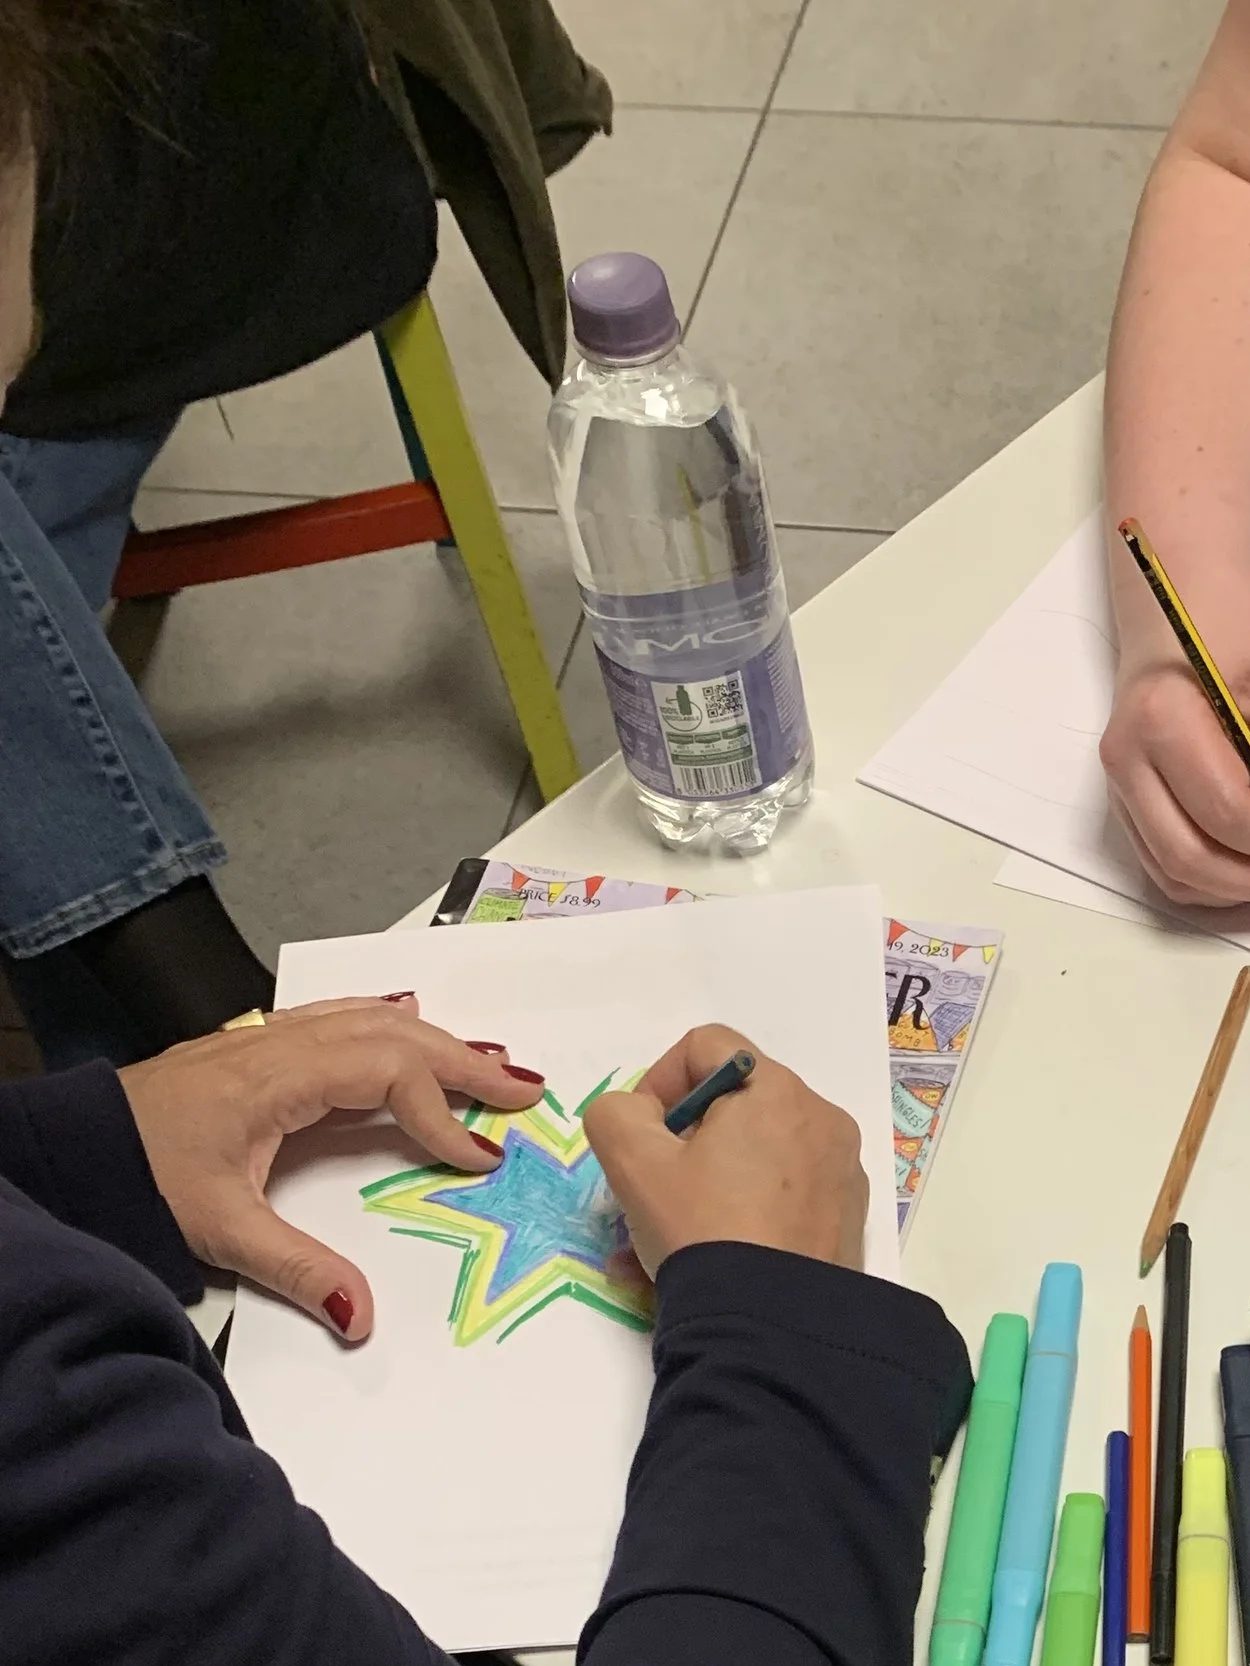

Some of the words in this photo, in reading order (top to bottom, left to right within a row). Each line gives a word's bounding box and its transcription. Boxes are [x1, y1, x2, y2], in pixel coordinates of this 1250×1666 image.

[517, 888, 556, 903] PRICE
[560, 894, 602, 909] $8.99
[909, 943, 950, 958] 2023
